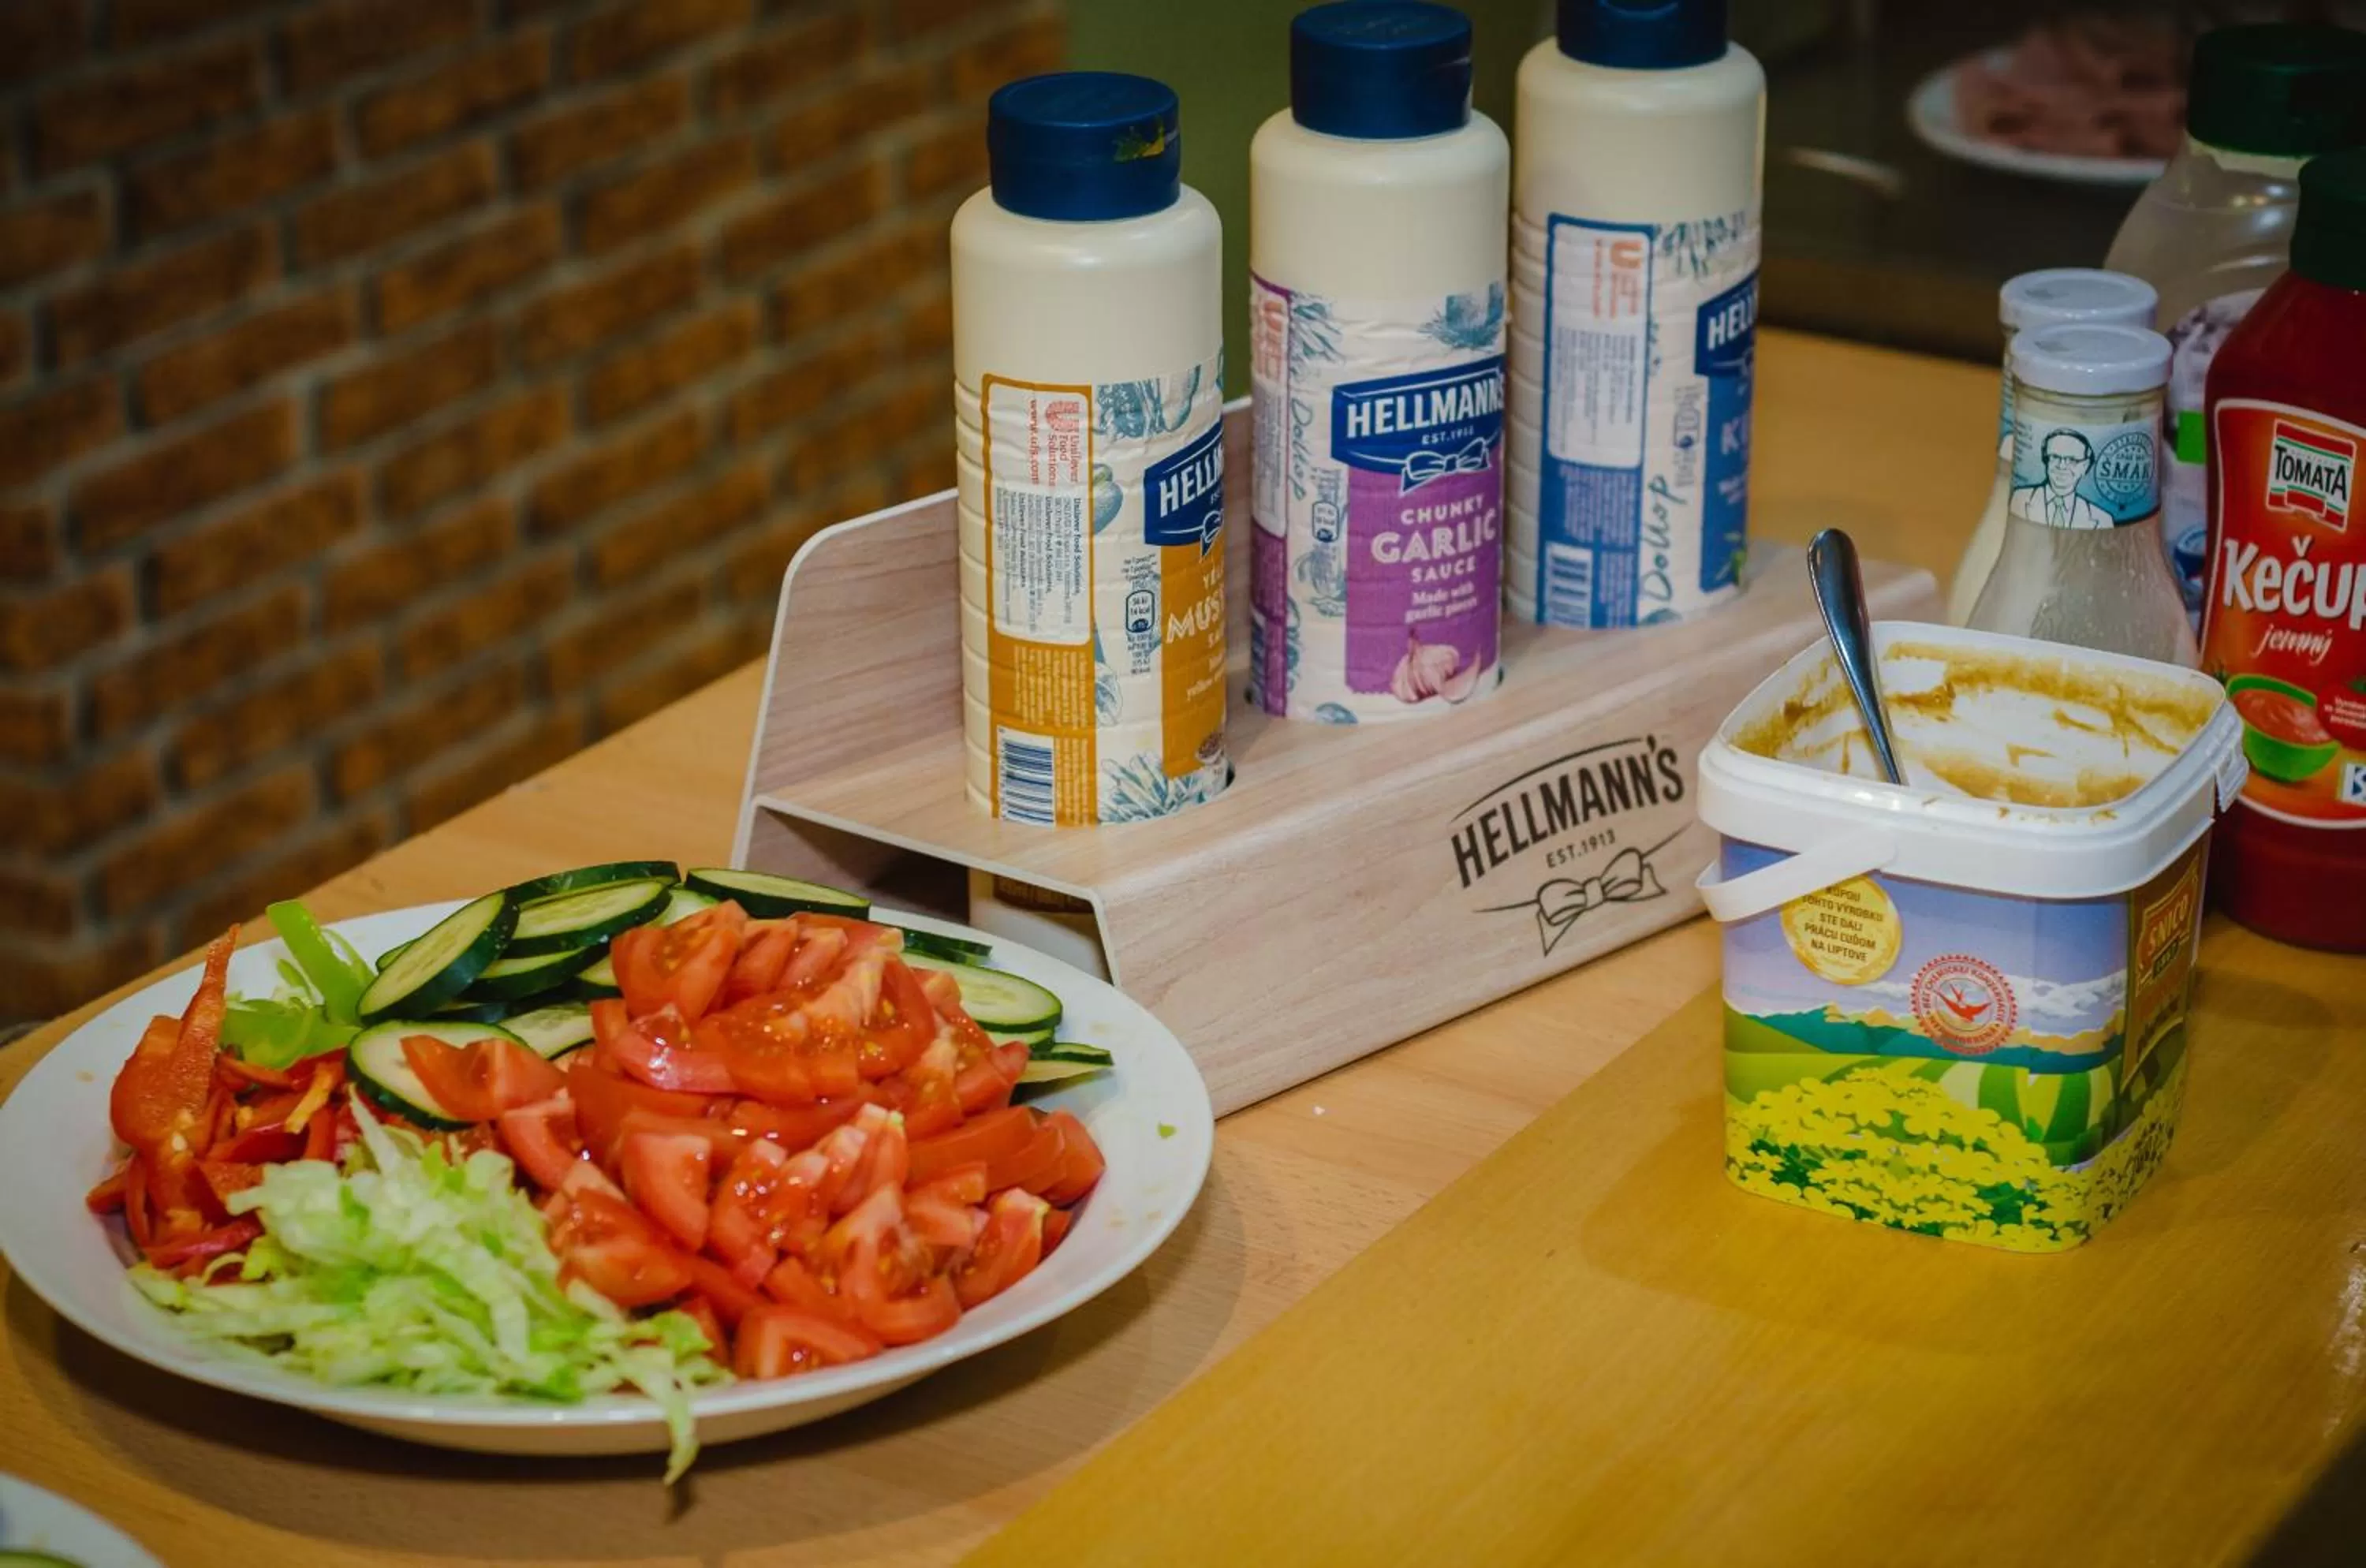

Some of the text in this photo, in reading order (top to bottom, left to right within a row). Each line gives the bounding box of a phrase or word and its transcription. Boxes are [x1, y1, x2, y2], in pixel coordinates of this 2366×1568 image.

[1069, 435, 1081, 483] Unilever
[2274, 444, 2349, 502] TOMATA
[1400, 494, 1484, 525] CHUNKY
[1370, 507, 1497, 564] GARLIC
[1410, 554, 1476, 584] SAUCE
[1450, 734, 1685, 890] HELLMANN'S
[1545, 828, 1617, 868] EST.1913
[1819, 913, 1864, 931] STE DALI
[1811, 938, 1868, 961] NA LIPTOVE
